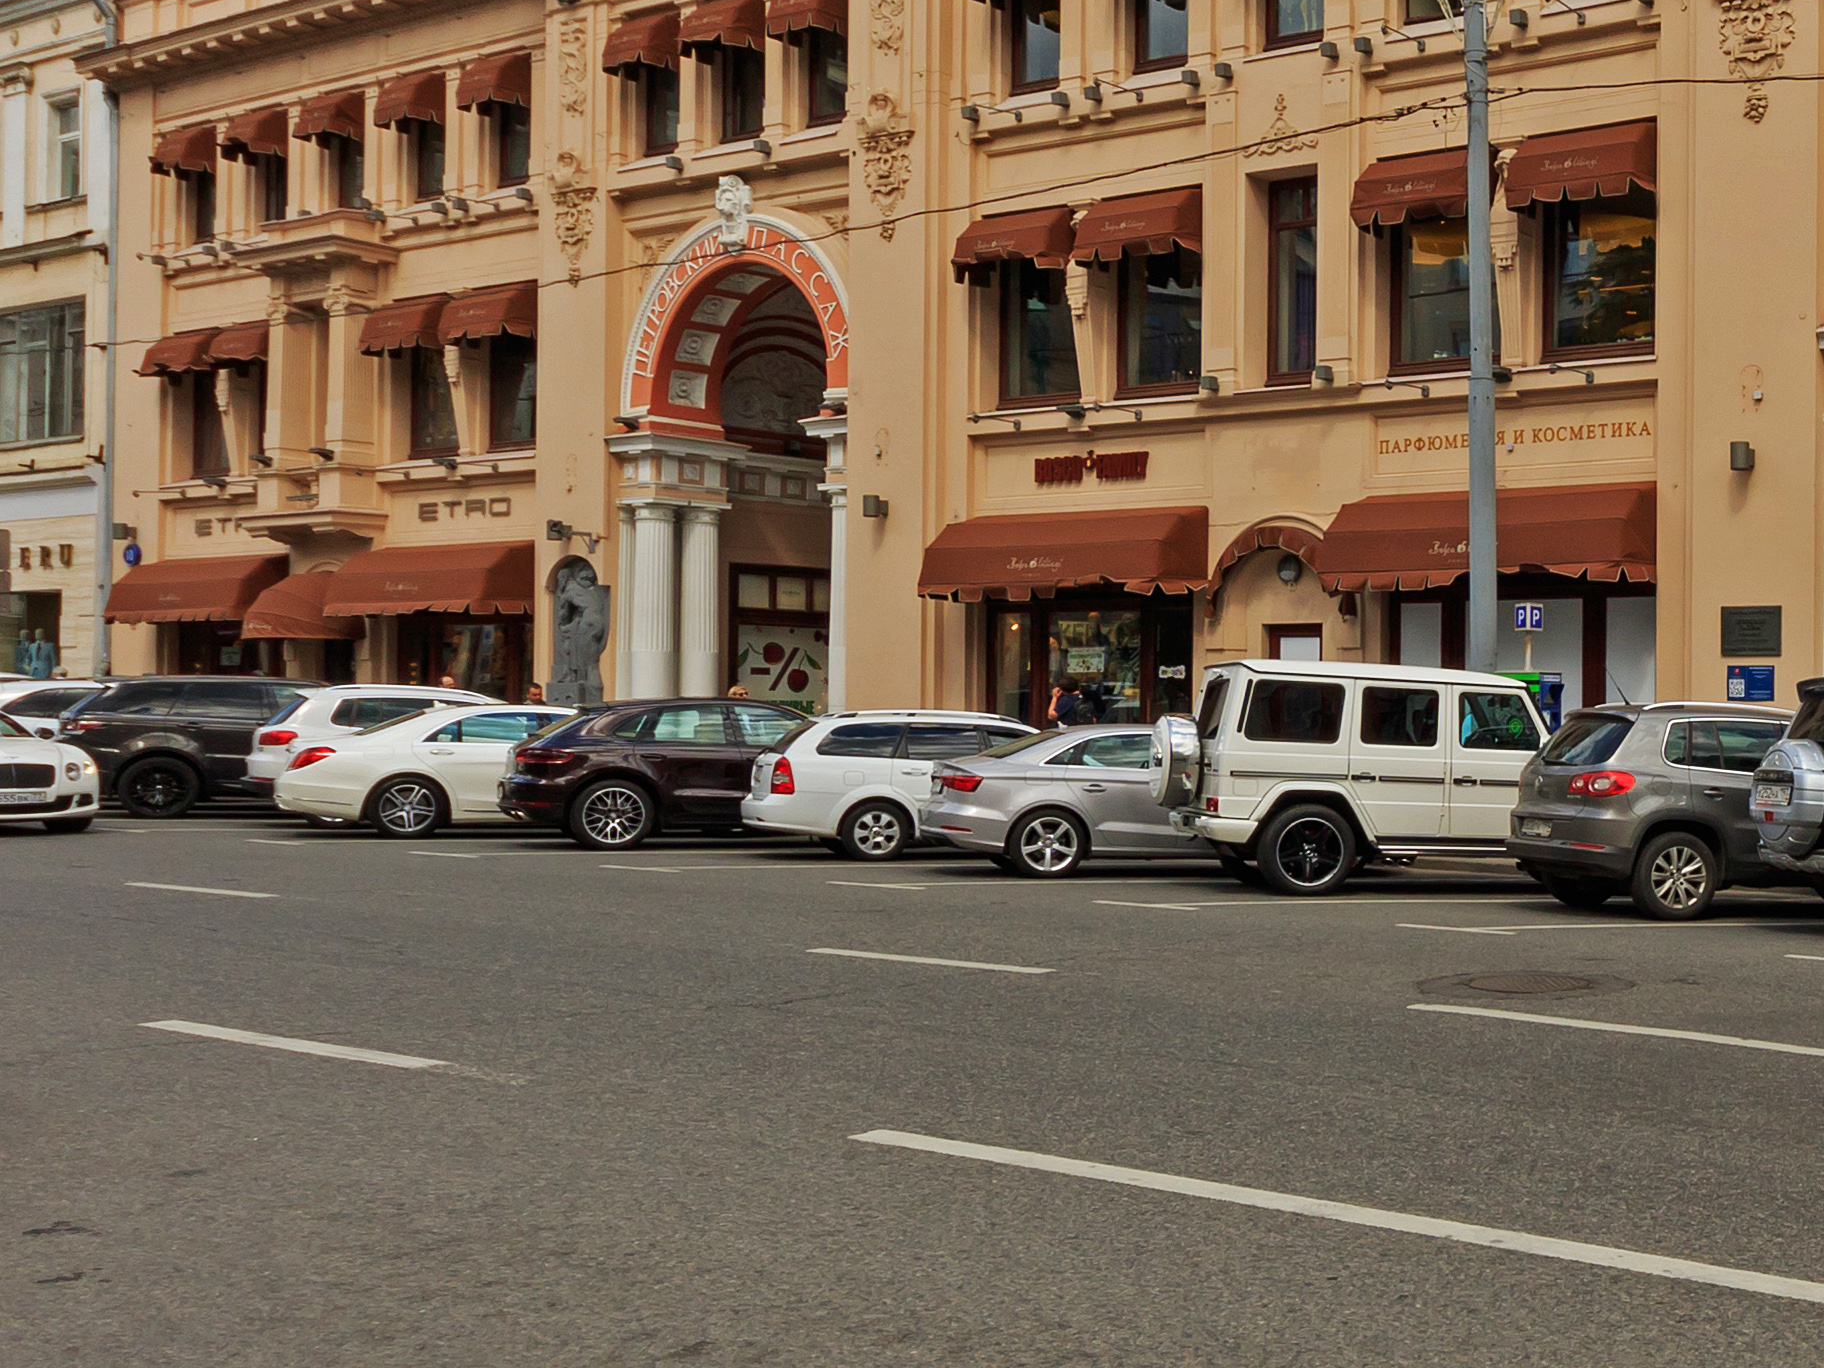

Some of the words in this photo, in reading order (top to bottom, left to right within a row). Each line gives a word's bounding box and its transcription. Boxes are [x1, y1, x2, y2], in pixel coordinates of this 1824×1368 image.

[633, 233, 723, 377] ПЕТРОВСКИЙ
[750, 227, 848, 360] ПАССАЖ
[1379, 430, 1506, 455] ПАРФЮМЕЯ
[1513, 429, 1525, 445] И
[1531, 420, 1652, 444] КОСМЕТИКА
[418, 497, 512, 522] ETRO
